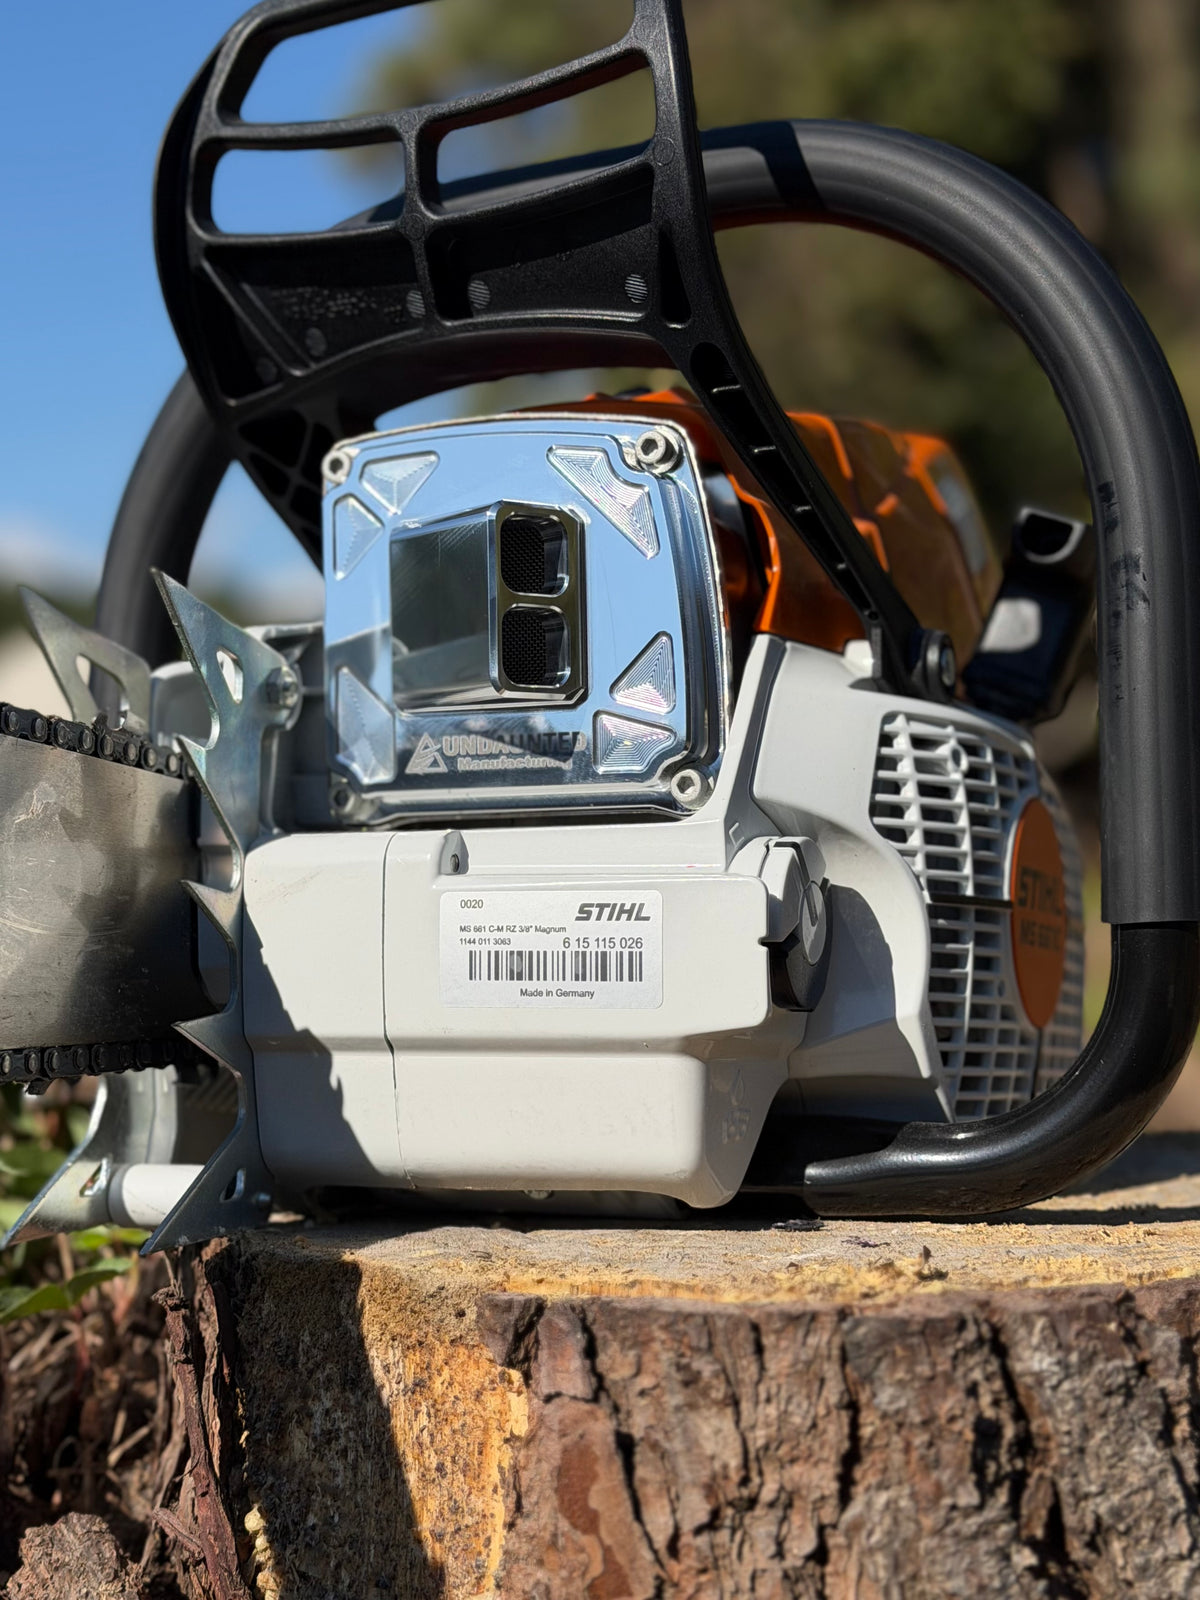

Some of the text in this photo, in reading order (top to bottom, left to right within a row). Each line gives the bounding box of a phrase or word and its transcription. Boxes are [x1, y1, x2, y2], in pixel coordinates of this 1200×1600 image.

[442, 732, 587, 757] UNDAUNTED
[460, 899, 484, 909] 0020
[575, 903, 651, 921] STIHL
[459, 925, 472, 933] MS
[488, 925, 504, 933] C-M
[506, 925, 517, 933] RZ
[534, 925, 567, 934] Magnum
[459, 938, 476, 946] 1144
[478, 938, 491, 946] 011
[562, 937, 643, 949] 6 15 115 026
[520, 989, 595, 999] Made in Germany
